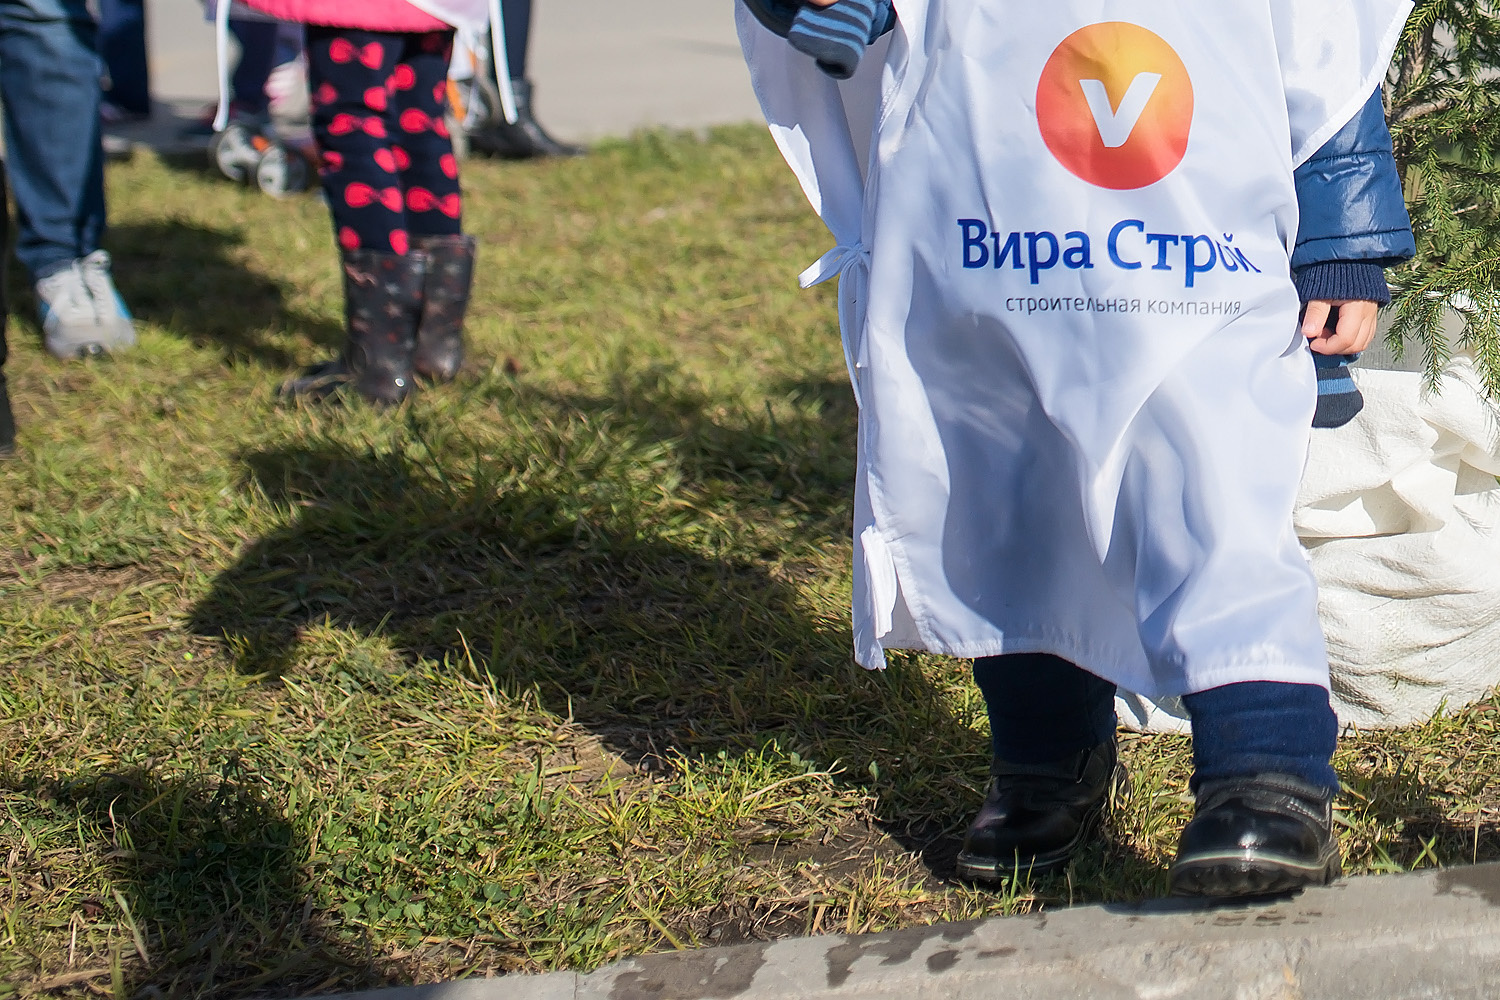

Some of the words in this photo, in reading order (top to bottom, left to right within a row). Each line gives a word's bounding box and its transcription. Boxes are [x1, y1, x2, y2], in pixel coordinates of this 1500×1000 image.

[957, 218, 1094, 285] Вира
[1005, 297, 1141, 316] строительная
[1147, 300, 1241, 315] компания
